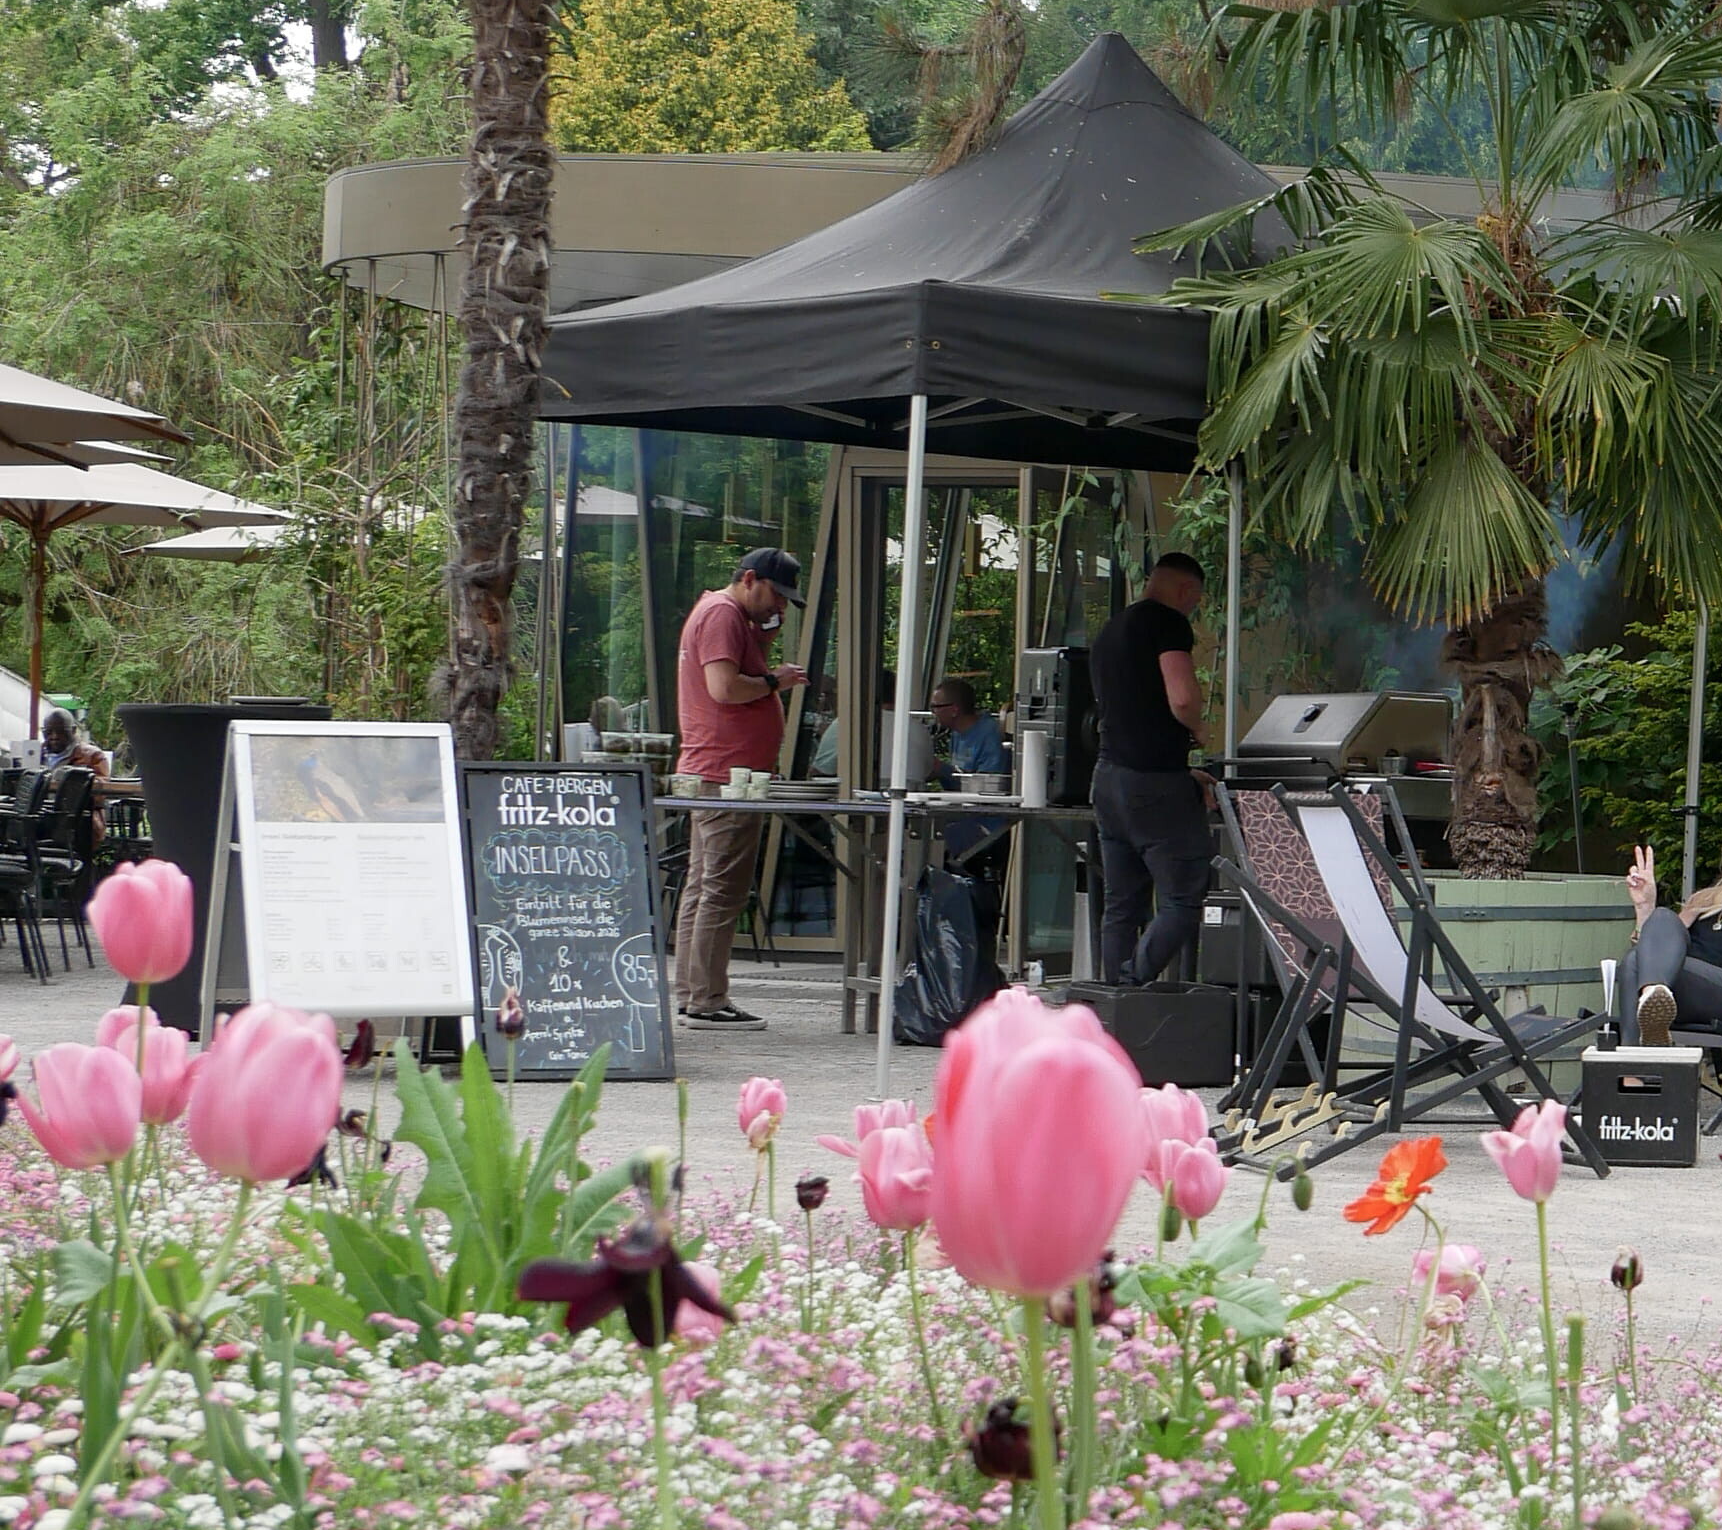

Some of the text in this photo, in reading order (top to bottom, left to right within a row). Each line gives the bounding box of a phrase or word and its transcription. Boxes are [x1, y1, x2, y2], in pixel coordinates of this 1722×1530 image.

[501, 776, 544, 794] CAFE
[497, 794, 616, 826] fritz-kola
[494, 845, 613, 879] INSELPASS
[515, 896, 562, 910] Eintritt
[592, 896, 612, 910] die
[595, 912, 616, 925] die
[557, 945, 574, 968] &
[1599, 1115, 1675, 1141] fritz-kola
